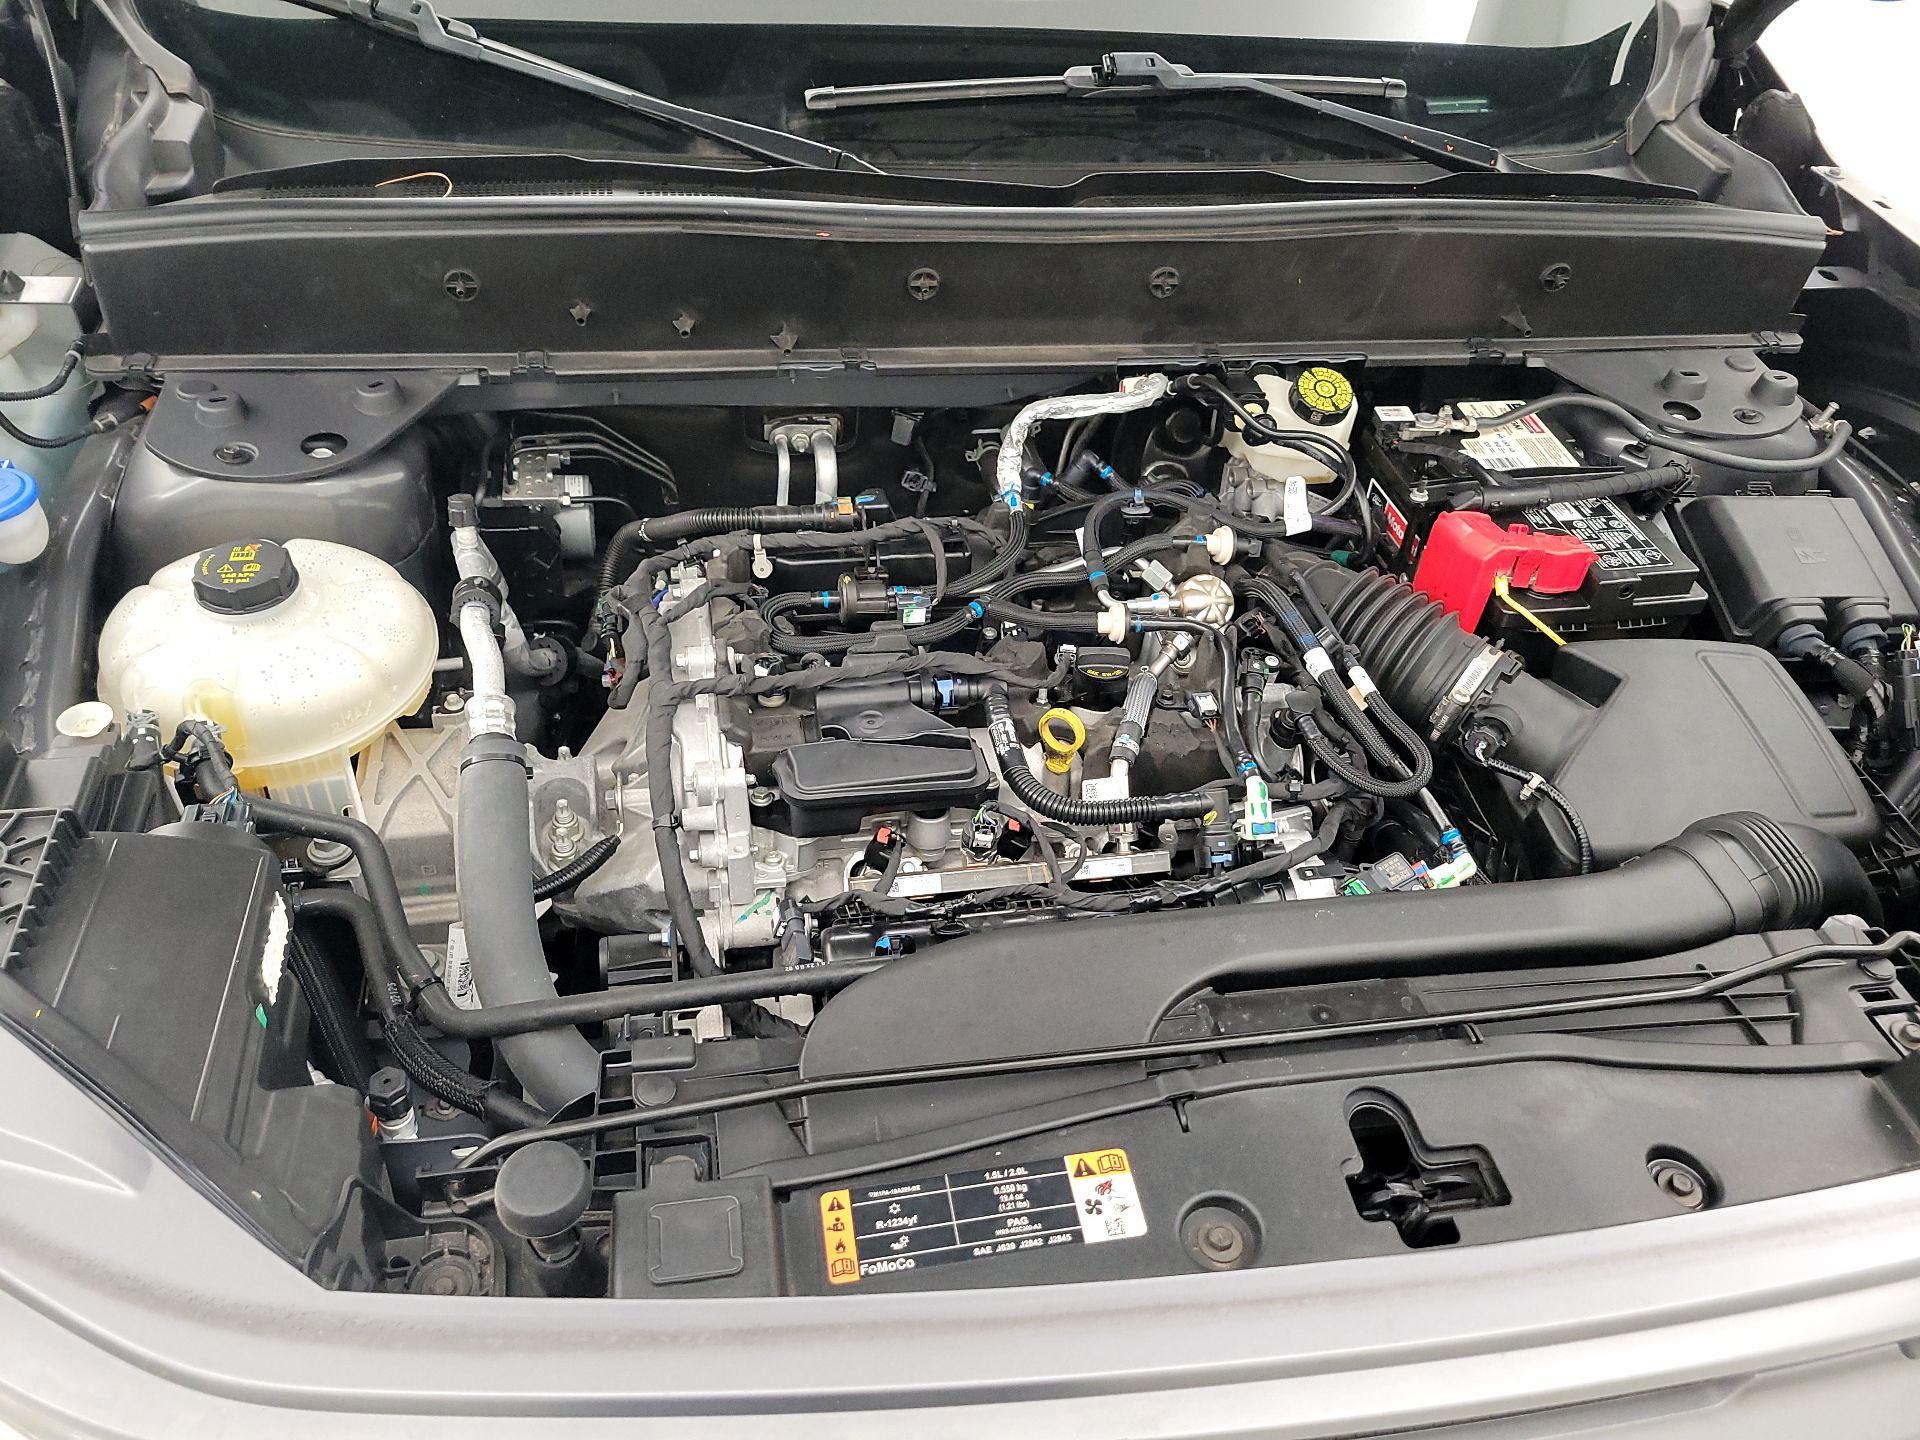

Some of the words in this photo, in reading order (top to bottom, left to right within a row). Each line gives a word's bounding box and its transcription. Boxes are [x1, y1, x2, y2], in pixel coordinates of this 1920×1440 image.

[1016, 1182, 1029, 1193] kg
[875, 1214, 918, 1230] R-1234yf
[1006, 1216, 1030, 1227] PAG
[972, 1246, 994, 1257] SAE
[859, 1257, 916, 1276] FoMoCo
